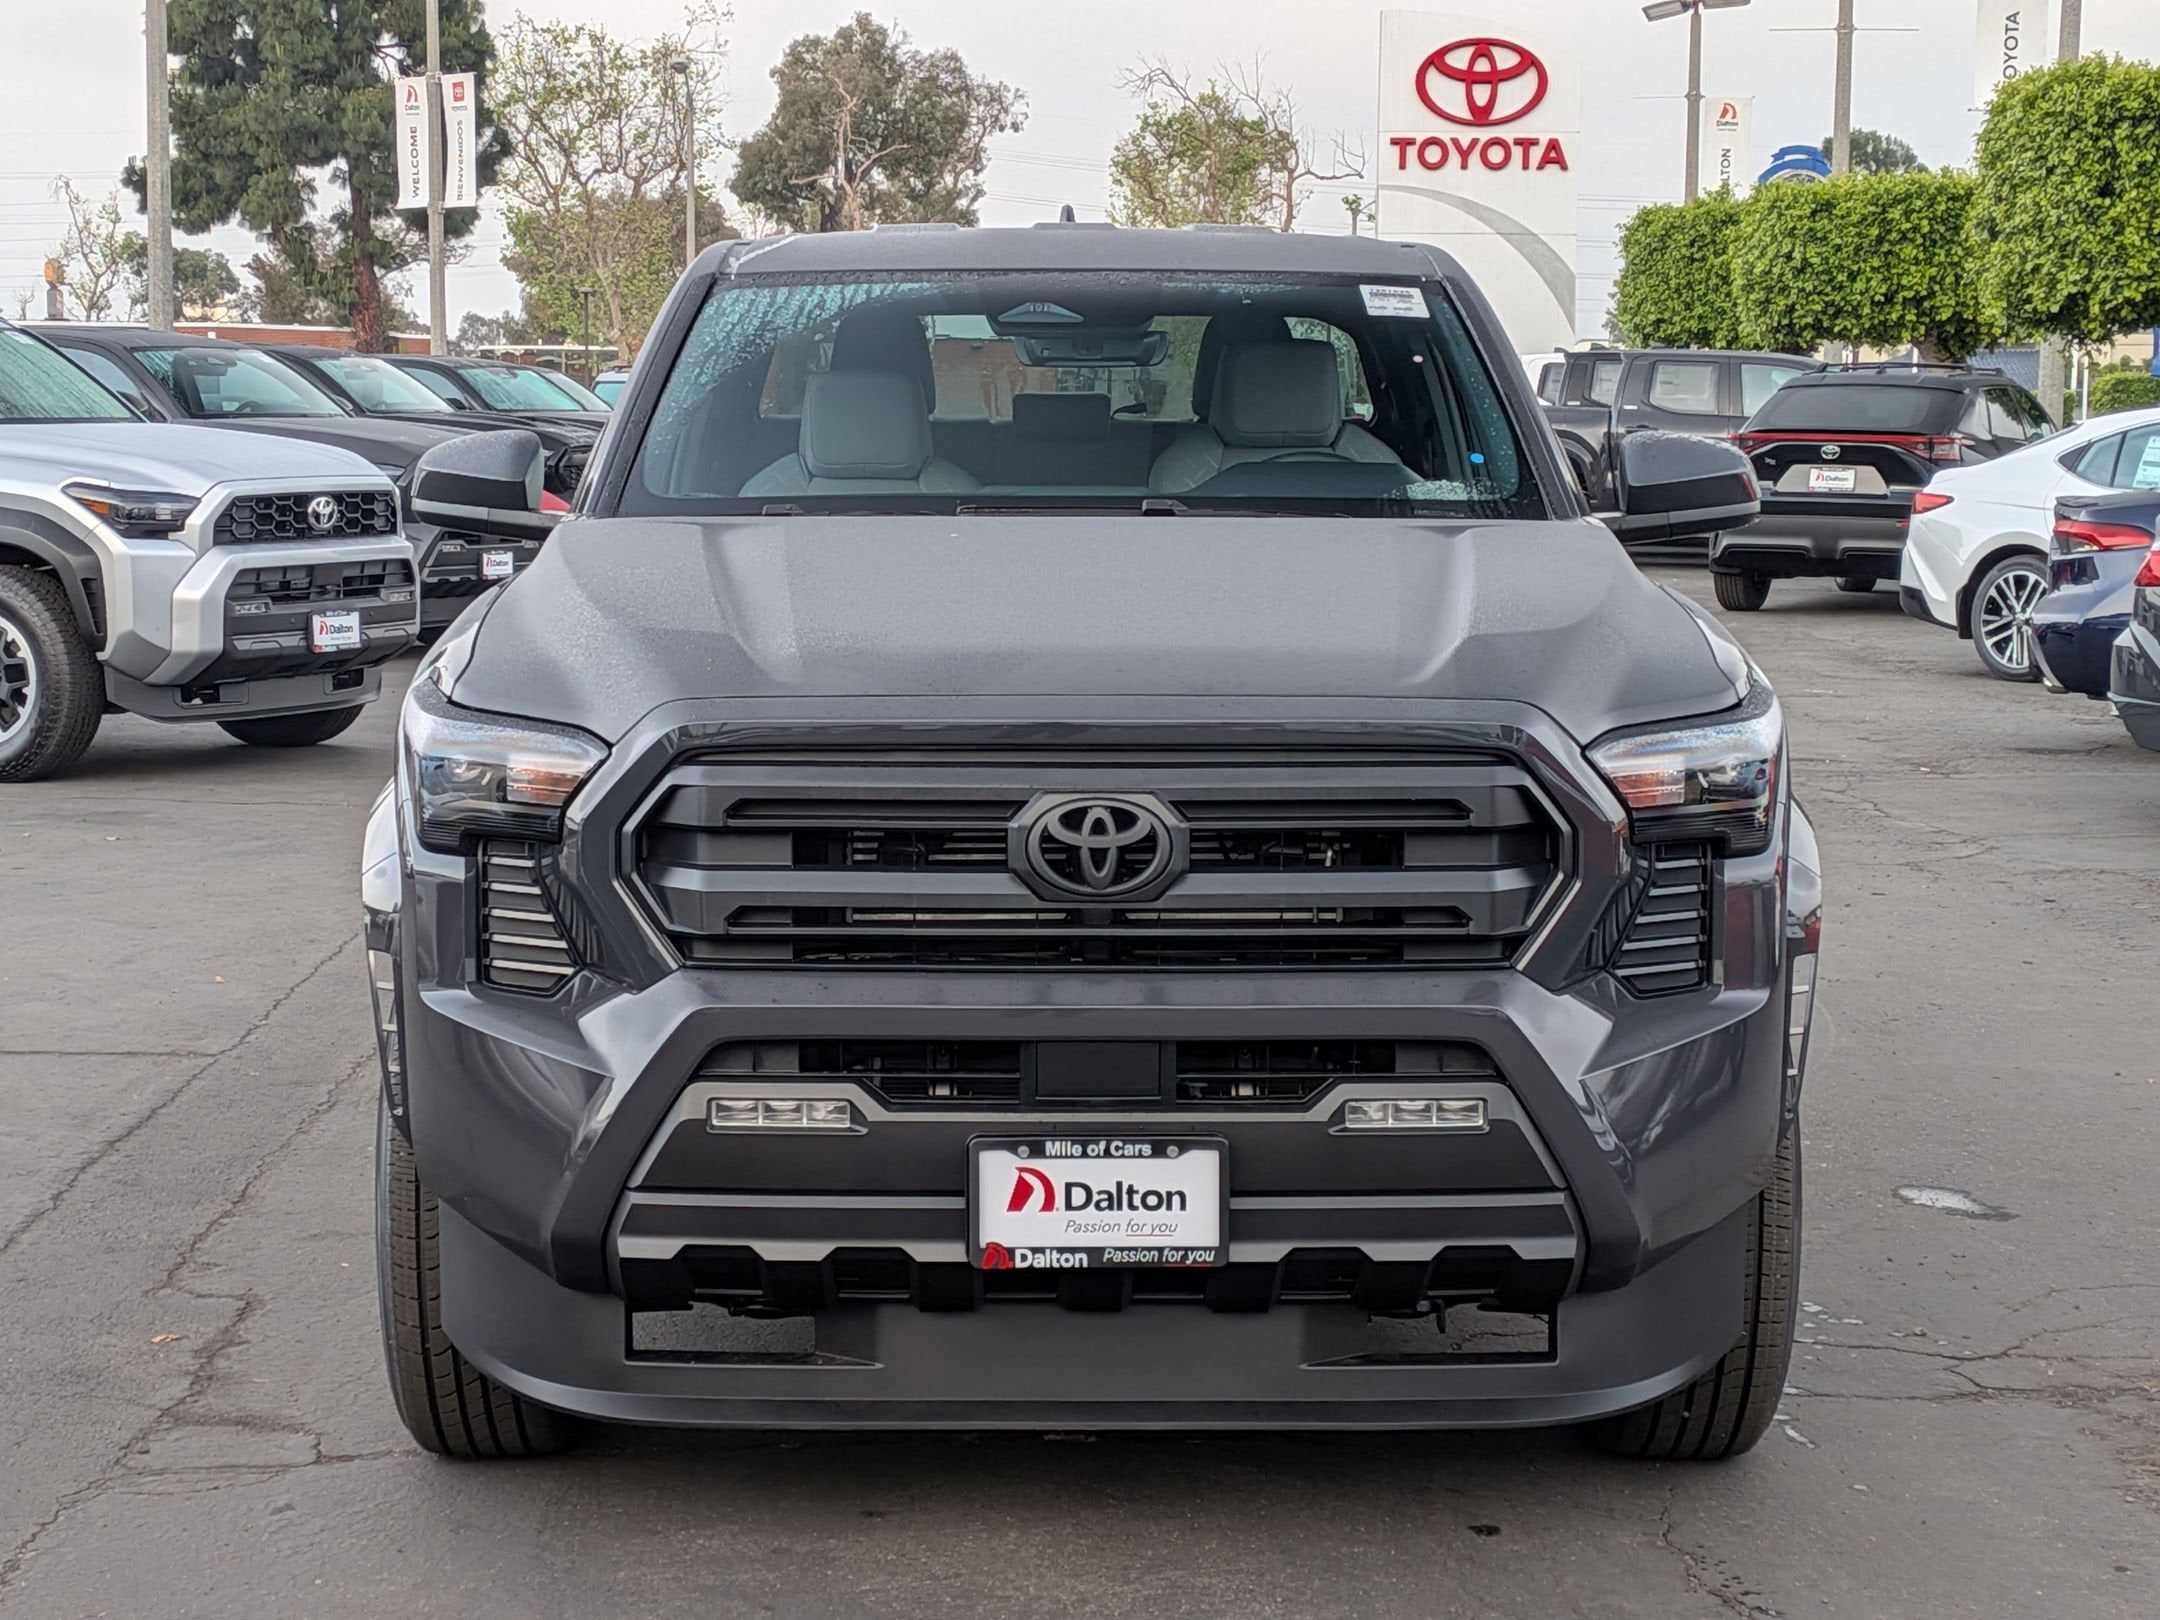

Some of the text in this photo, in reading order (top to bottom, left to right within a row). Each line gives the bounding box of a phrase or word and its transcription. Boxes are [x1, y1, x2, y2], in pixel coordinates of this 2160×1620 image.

[2003, 11, 2020, 80] OYOTA
[410, 126, 420, 199] WELCOME
[456, 119, 464, 201] BIENVENIDOS
[1389, 136, 1569, 172] TOYOTA
[1720, 148, 1731, 183] LTON
[329, 624, 354, 634] Dalton
[1045, 1140, 1153, 1157] Mile of Cars
[1064, 1181, 1187, 1212] Dalton
[1064, 1218, 1178, 1236] Passion for you
[1014, 1248, 1216, 1268] Dalton Passion for you
